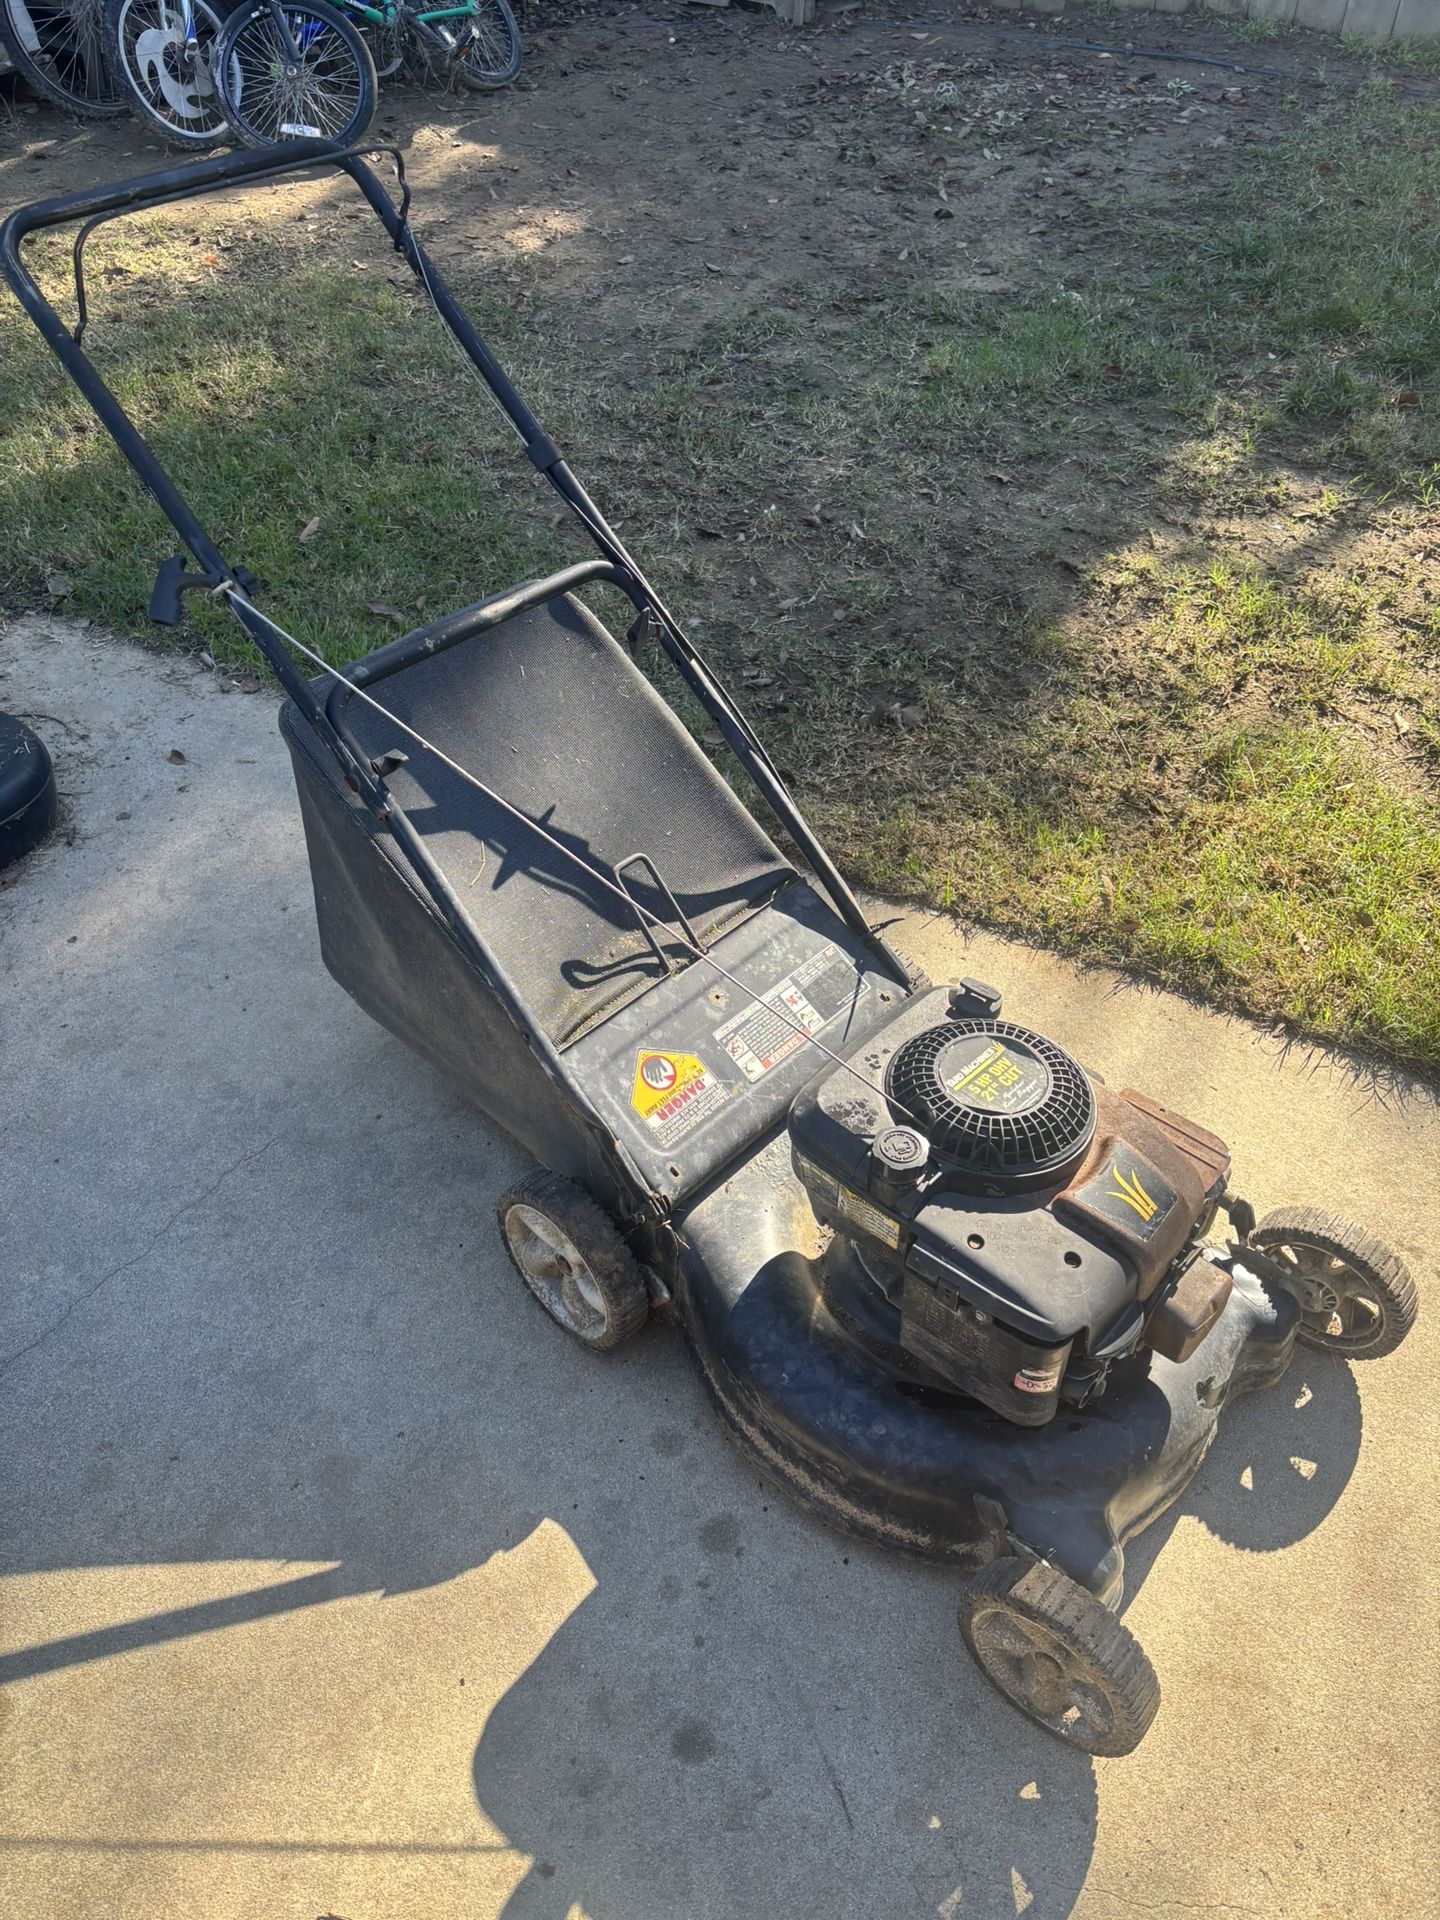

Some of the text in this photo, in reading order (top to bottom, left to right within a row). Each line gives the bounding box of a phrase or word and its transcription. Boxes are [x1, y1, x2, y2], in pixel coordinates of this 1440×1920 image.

[945, 1071, 965, 1088] YARD
[960, 1046, 995, 1077] MACHINES
[969, 1083, 981, 1095] 5
[976, 1072, 994, 1089] HP
[989, 1056, 1013, 1078] OHV
[998, 1065, 1024, 1088] CUT
[656, 1078, 706, 1122] DANGER
